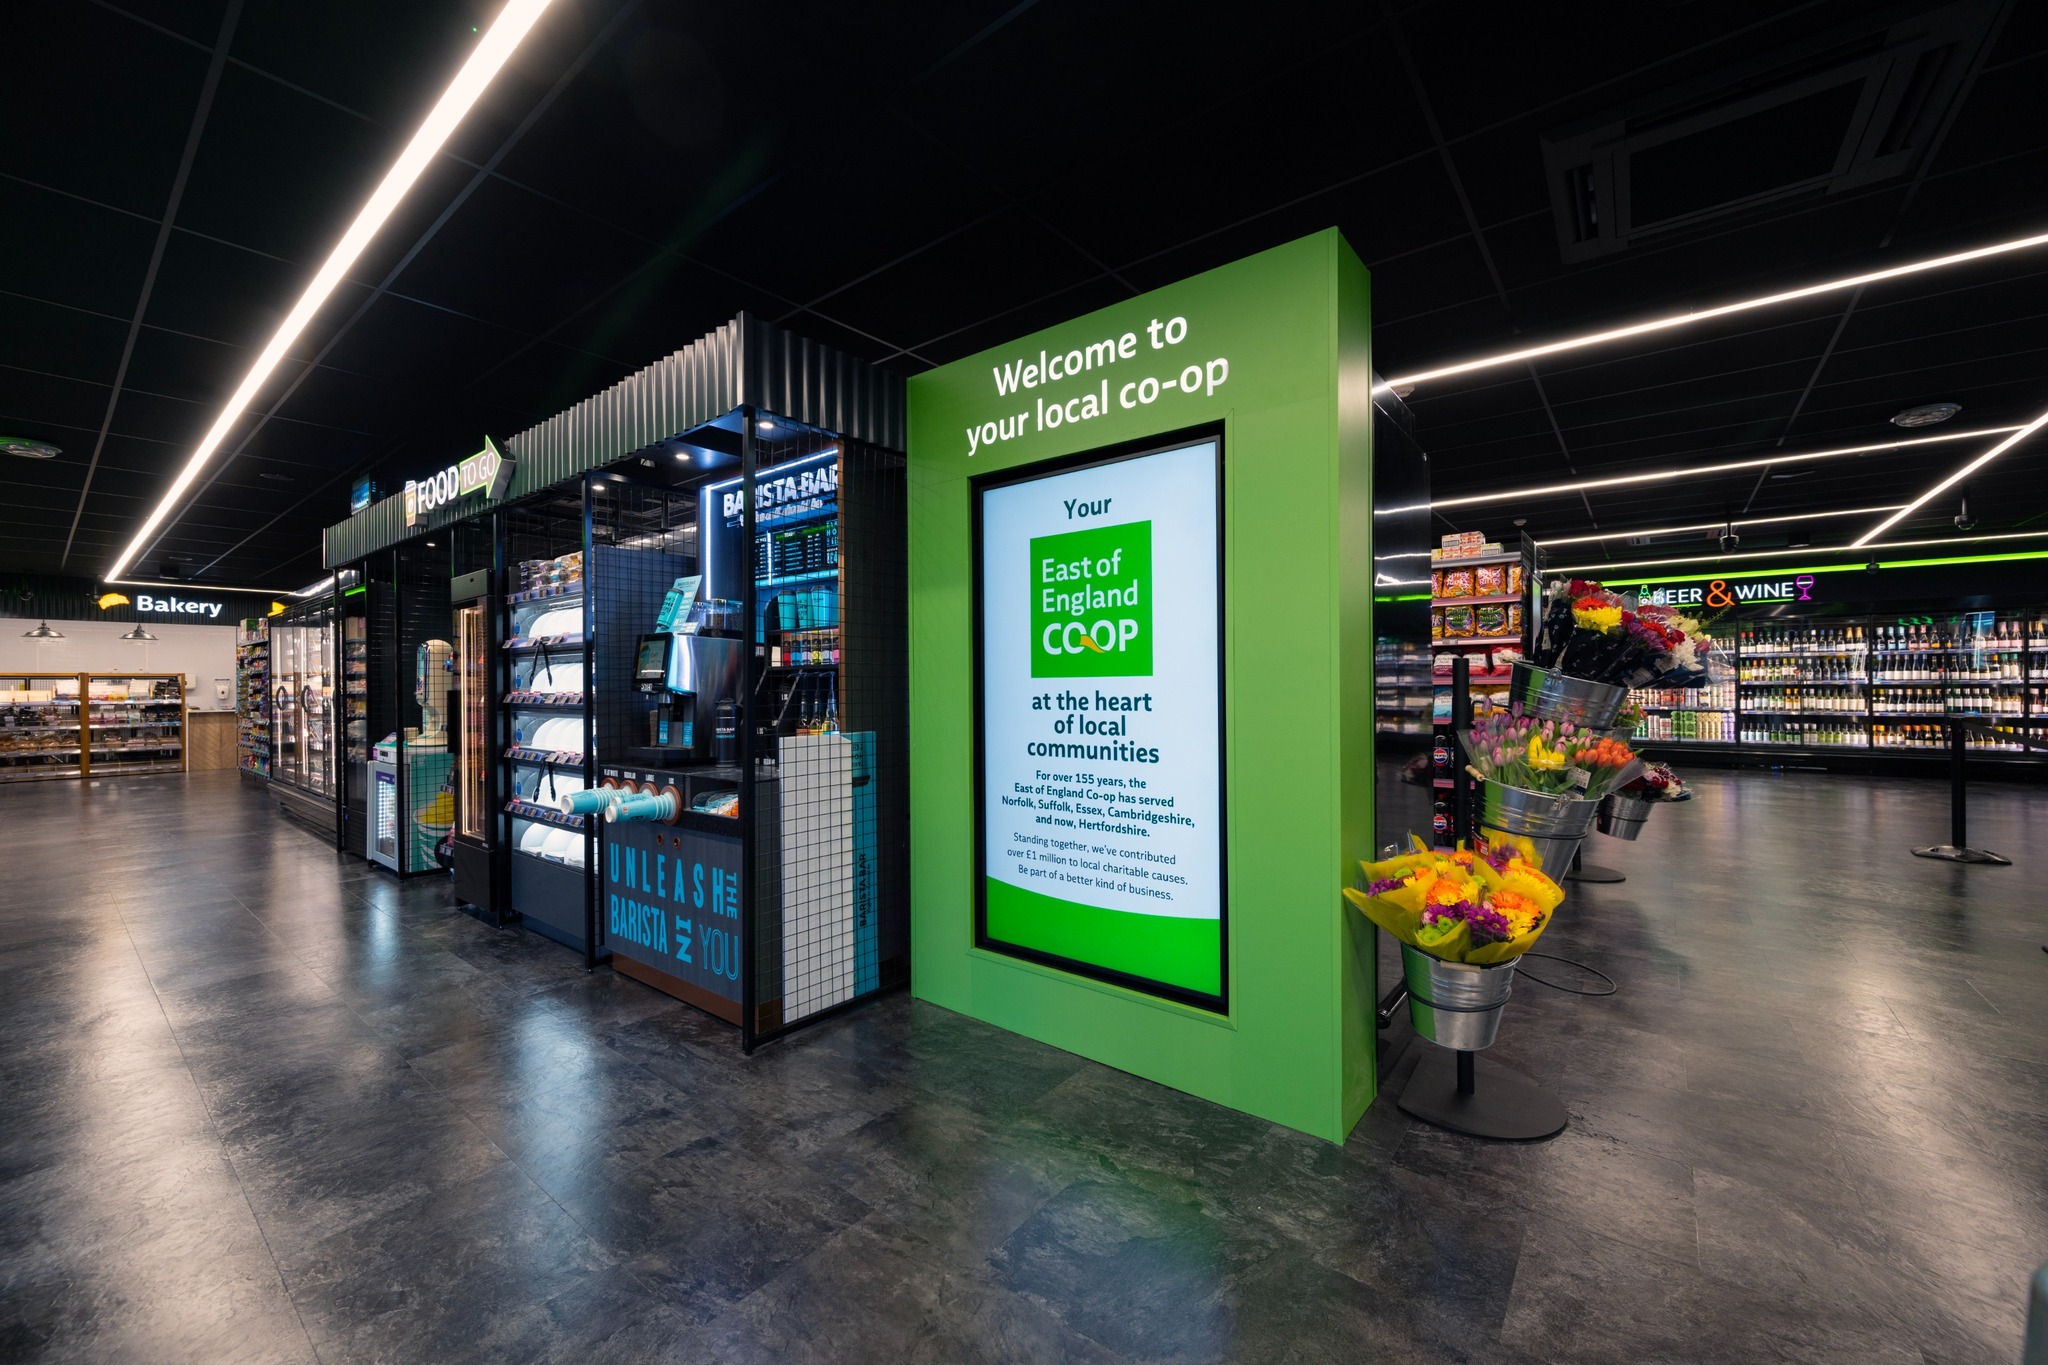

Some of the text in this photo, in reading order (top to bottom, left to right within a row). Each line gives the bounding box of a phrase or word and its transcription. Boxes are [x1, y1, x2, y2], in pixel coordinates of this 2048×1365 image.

[993, 315, 1188, 396] Welcome to
[967, 357, 1229, 456] your local co-op
[418, 452, 495, 513] FOOD TO GO
[1063, 497, 1112, 520] Your
[1042, 548, 1122, 582] East of
[137, 595, 222, 618] Bakery
[1042, 579, 1138, 615] England
[1653, 580, 1794, 608] BEER & WINE
[1032, 690, 1152, 712] at the heart
[1054, 714, 1126, 736] of local
[1027, 740, 1159, 763] communities
[1036, 770, 1146, 788] For over 155 years, the
[1015, 783, 1174, 807] East of England Co-op has served
[1002, 796, 1195, 827] Norfolk, Suffolk, Essex, Cambridgeshire,
[1035, 814, 1150, 837] and now, Hertfordshire.
[1013, 832, 1176, 864] Standing together, we've contributed
[610, 843, 737, 919] UNLEASH THE
[1007, 849, 1188, 885] over £1 million to local charitable causes.
[1018, 865, 1028, 874] Be
[1030, 867, 1047, 879] part
[1048, 869, 1057, 879] of
[1066, 873, 1093, 885] better
[1095, 878, 1115, 891] kind
[1117, 882, 1127, 892] of
[1129, 884, 1174, 900] business.
[611, 894, 739, 980] BARISTA IN YOU
